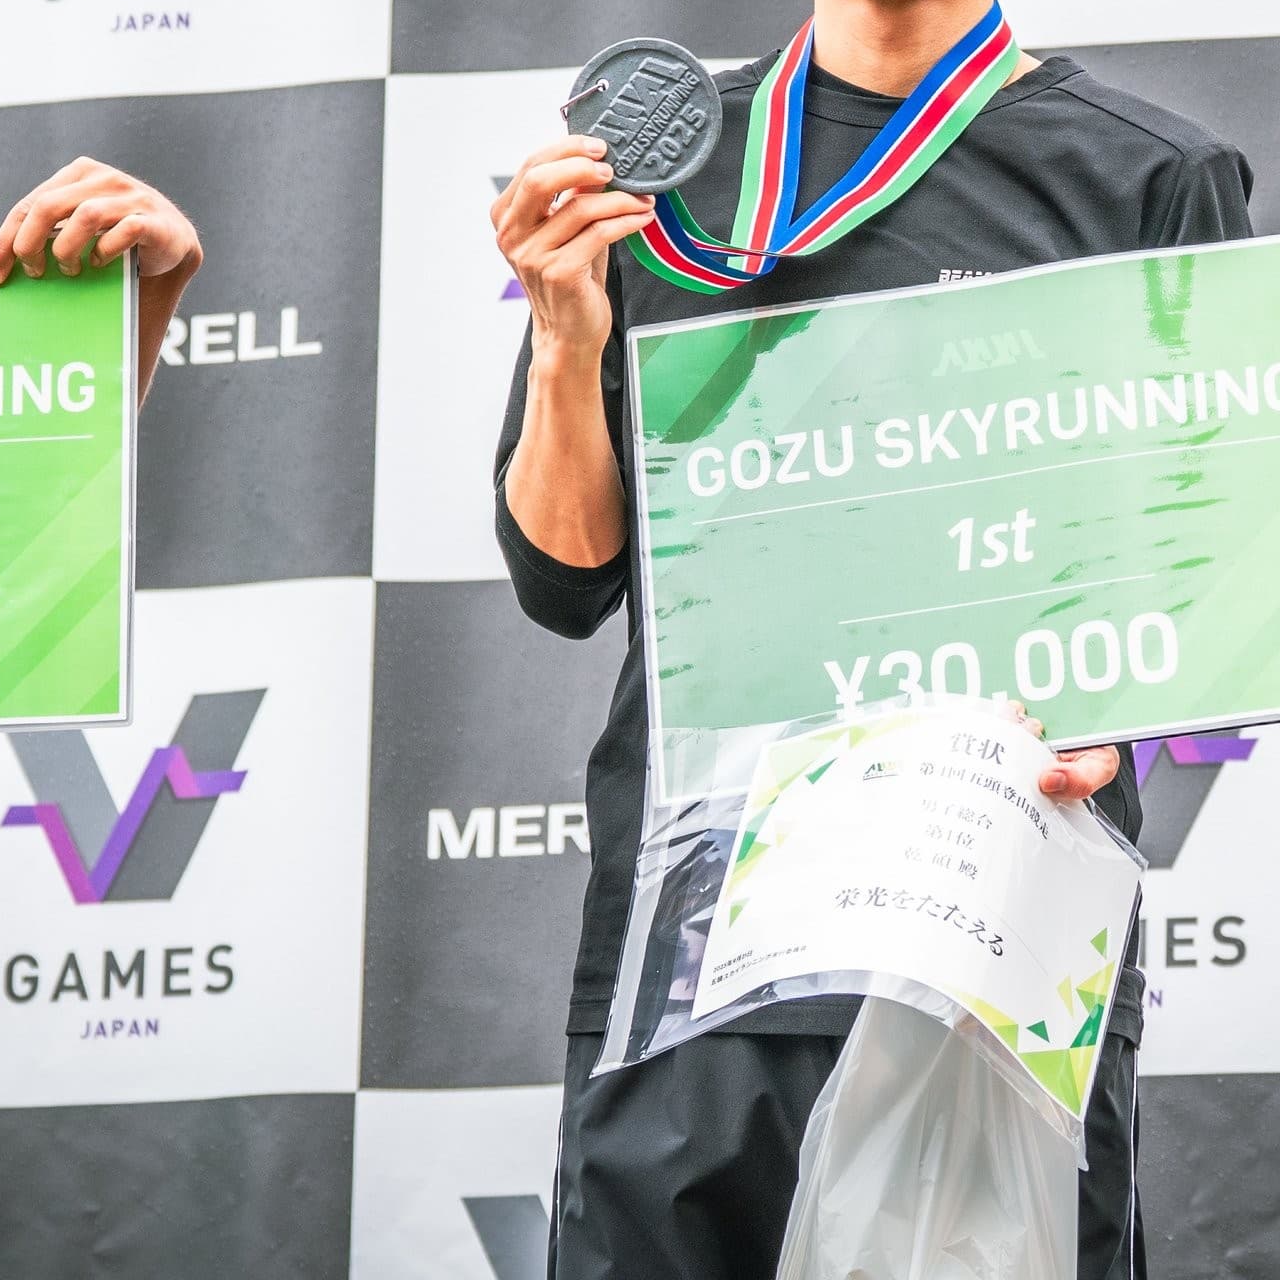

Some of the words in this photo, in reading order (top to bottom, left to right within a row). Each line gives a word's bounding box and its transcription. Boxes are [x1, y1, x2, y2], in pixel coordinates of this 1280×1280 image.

[110, 11, 192, 33] JAPAN
[644, 102, 707, 176] 2025
[159, 306, 323, 367] RELL
[686, 425, 854, 498] GOZU
[947, 508, 1038, 573] 1st
[834, 886, 1004, 957] 栄光をたたえる
[3, 943, 236, 1004] GAMES
[80, 1017, 161, 1040] JAPAN
